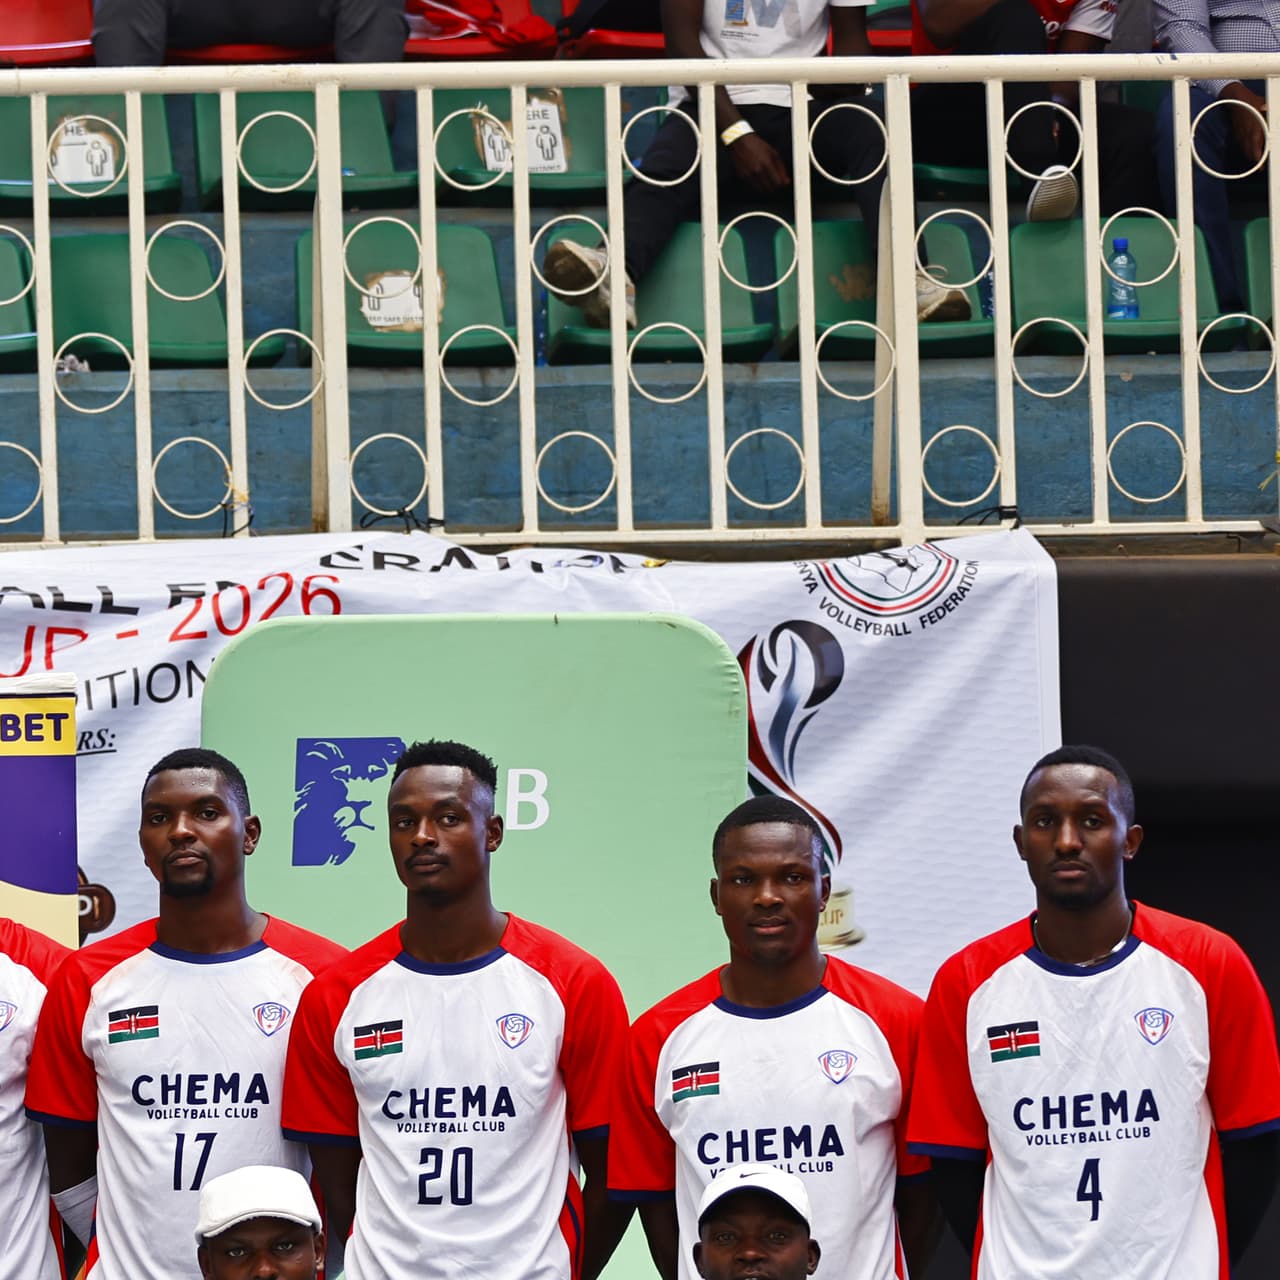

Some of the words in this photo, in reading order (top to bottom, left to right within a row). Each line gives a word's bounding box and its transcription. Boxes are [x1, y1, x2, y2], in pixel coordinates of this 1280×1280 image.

[168, 571, 341, 642] 2026
[818, 596, 912, 637] VOLLEYBALL
[918, 559, 979, 630] FEDERATION
[84, 656, 214, 710] ITION
[0, 711, 70, 744] BET
[131, 1072, 270, 1106] CHEMA
[382, 1084, 516, 1121] CHEMA
[1013, 1088, 1159, 1132] CHEMA
[147, 1107, 222, 1121] VOLLEYBALL
[226, 1106, 259, 1119] CLUB
[397, 1120, 469, 1134] VOLLEYBALL
[471, 1120, 505, 1133] CLUB
[697, 1123, 846, 1166] CHEMA
[1026, 1129, 1111, 1147] VOLLEYBALL
[1114, 1126, 1151, 1140] CLUB
[172, 1131, 218, 1191] 17
[417, 1146, 474, 1206] 20
[798, 1160, 834, 1173] CLUB
[1076, 1157, 1103, 1221] 4
